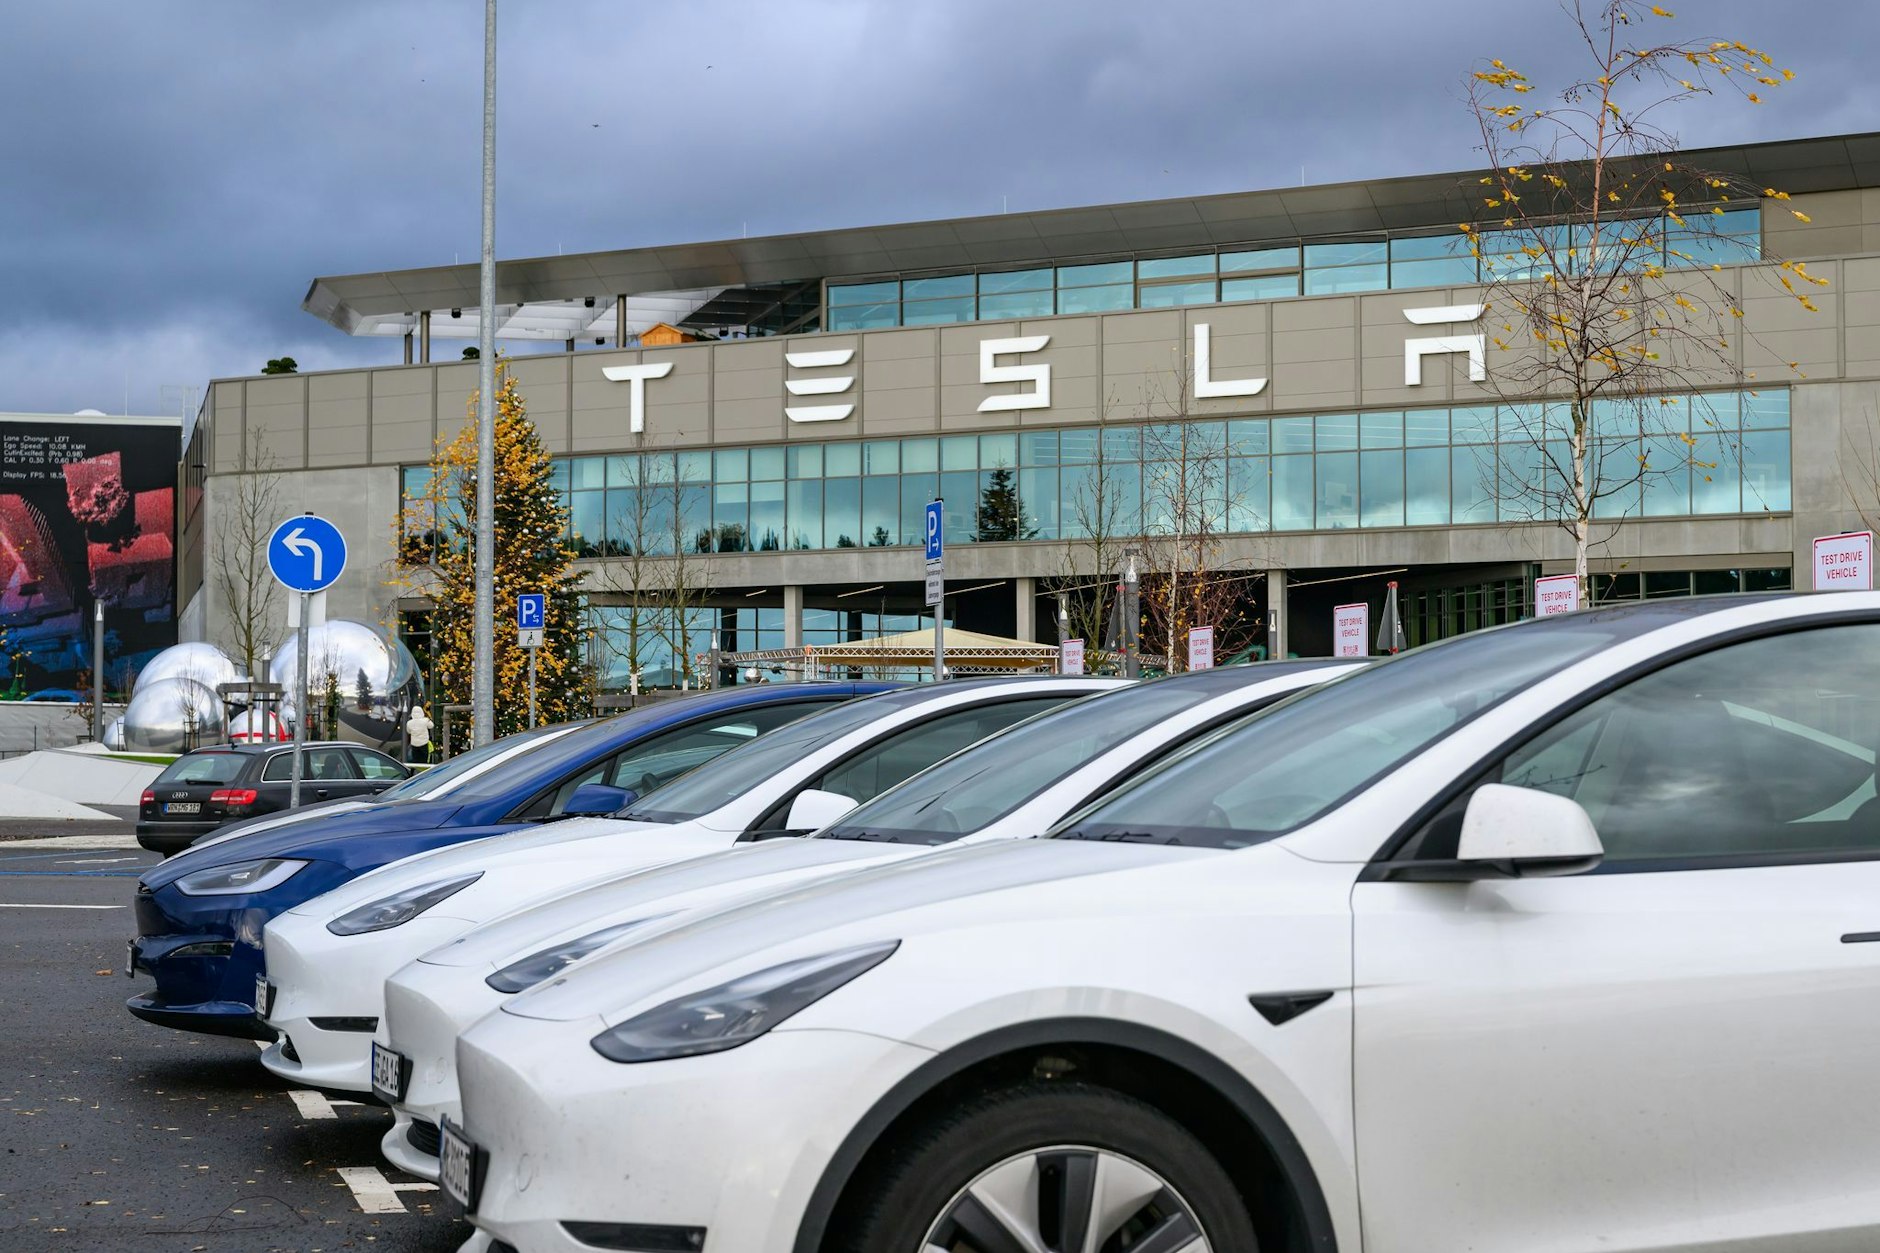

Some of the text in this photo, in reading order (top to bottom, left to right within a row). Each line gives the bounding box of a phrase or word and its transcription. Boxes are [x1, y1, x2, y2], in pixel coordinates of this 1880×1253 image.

[602, 303, 1486, 433] TESLA
[23, 435, 50, 443] Change:
[4, 442, 17, 450] Ego
[20, 442, 42, 450] Speed:
[3, 471, 27, 479] Display
[928, 510, 938, 553] P
[1821, 551, 1863, 565] TEST DRIVE
[1826, 567, 1857, 580] VEHICLE
[1541, 590, 1572, 602] TEST DRIVE
[522, 599, 536, 624] P
[1545, 604, 1568, 614] VEHICLE
[1339, 617, 1362, 626] TEST DRIVE
[1342, 628, 1359, 637] VEHICLE
